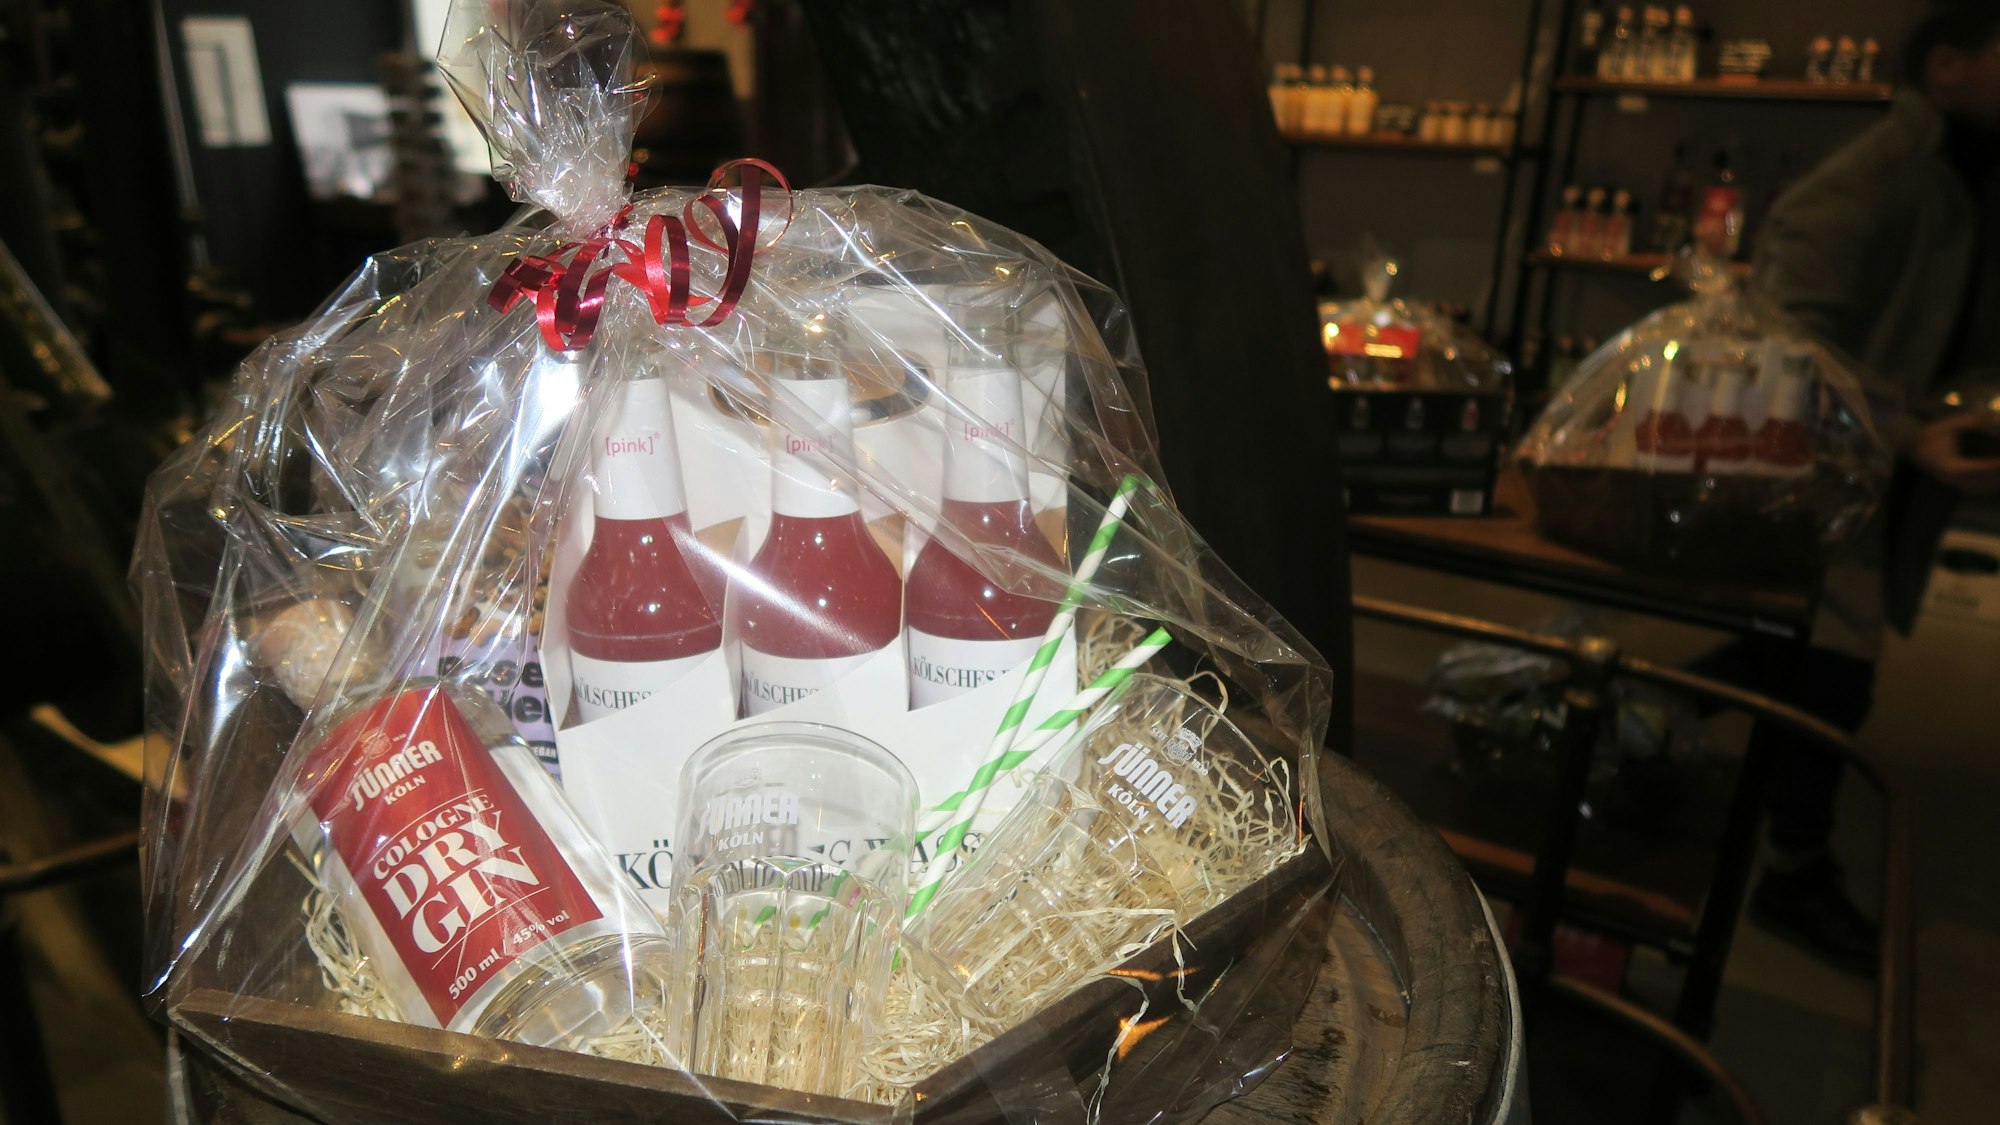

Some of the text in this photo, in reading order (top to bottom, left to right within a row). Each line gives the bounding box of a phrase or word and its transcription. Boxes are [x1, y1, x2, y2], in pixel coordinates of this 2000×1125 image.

[351, 740, 443, 811] SÜNNER
[384, 775, 426, 805] KÖLN
[1097, 742, 1197, 829] SÜNNER
[1107, 783, 1149, 820] KÖLN
[373, 794, 495, 879] COLOGNE
[382, 810, 508, 920] DRY
[718, 831, 763, 851] KÖLN
[413, 846, 540, 953] GIN
[449, 910, 570, 1000] 500 ml 45% vol
